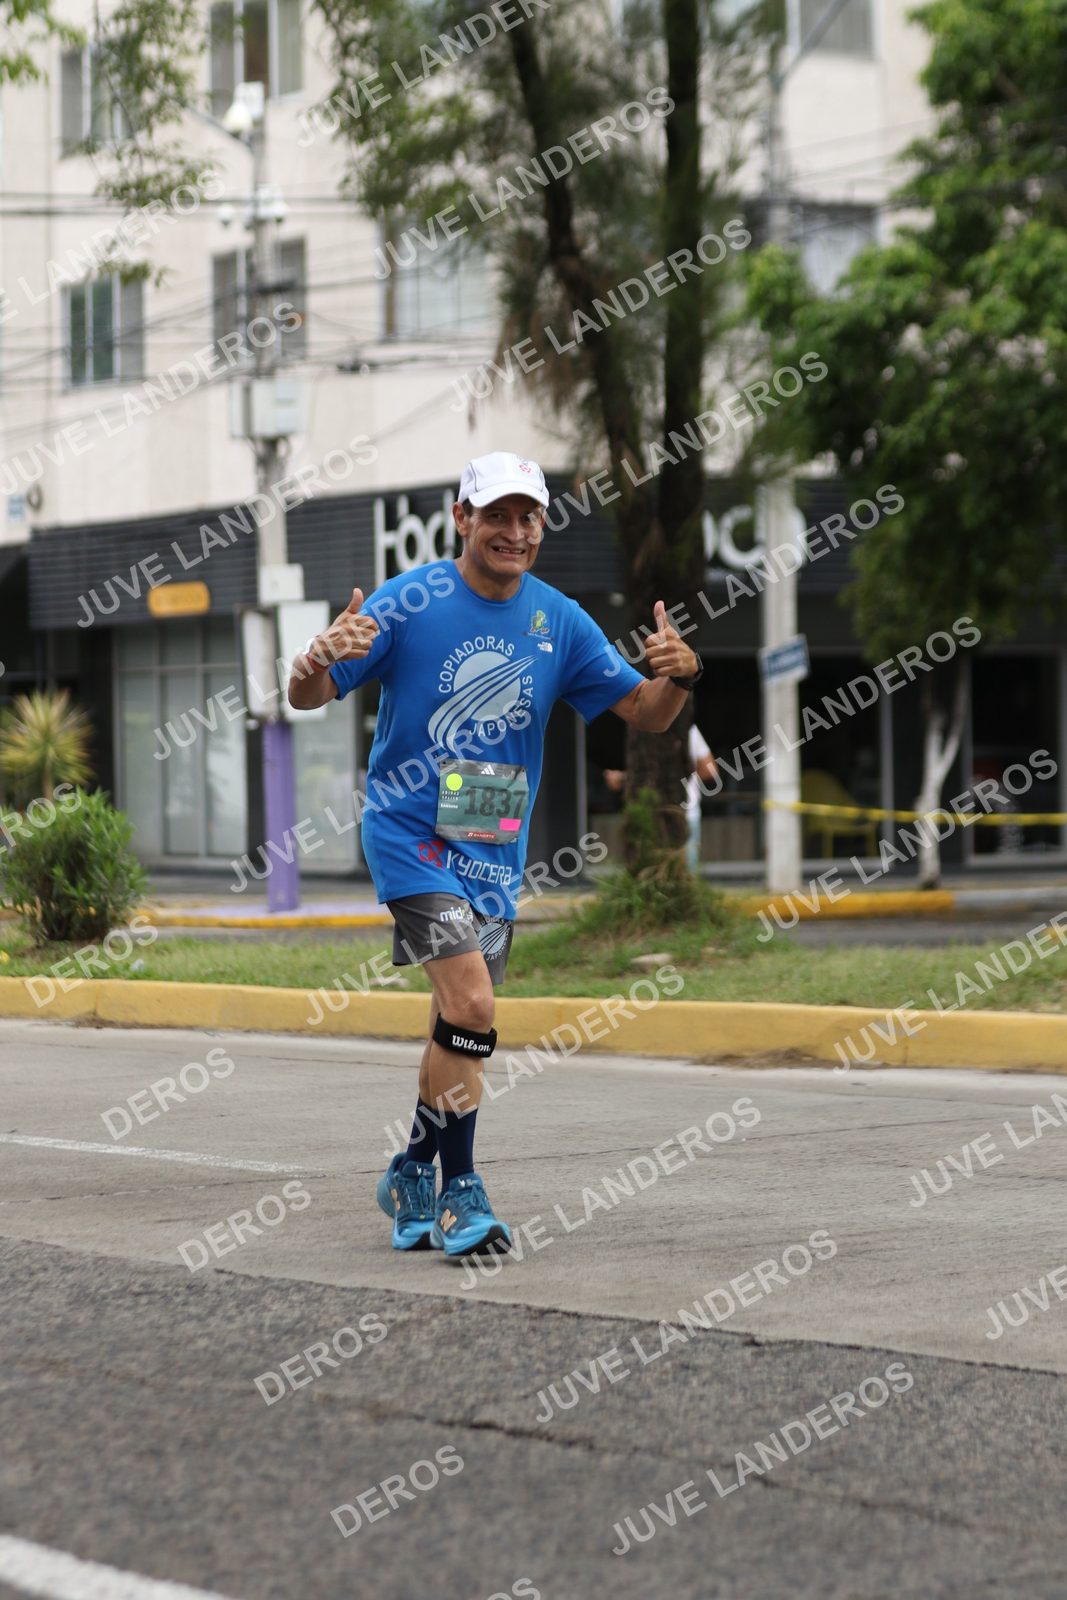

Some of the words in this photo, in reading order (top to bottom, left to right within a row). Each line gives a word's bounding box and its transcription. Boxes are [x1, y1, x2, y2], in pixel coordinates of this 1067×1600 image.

[439, 635, 515, 693] COPIADORAS
[469, 675, 533, 737] JAPONESAS
[464, 786, 526, 819] 1837
[447, 850, 512, 885] KYOCERA
[452, 1035, 489, 1052] Wilson
